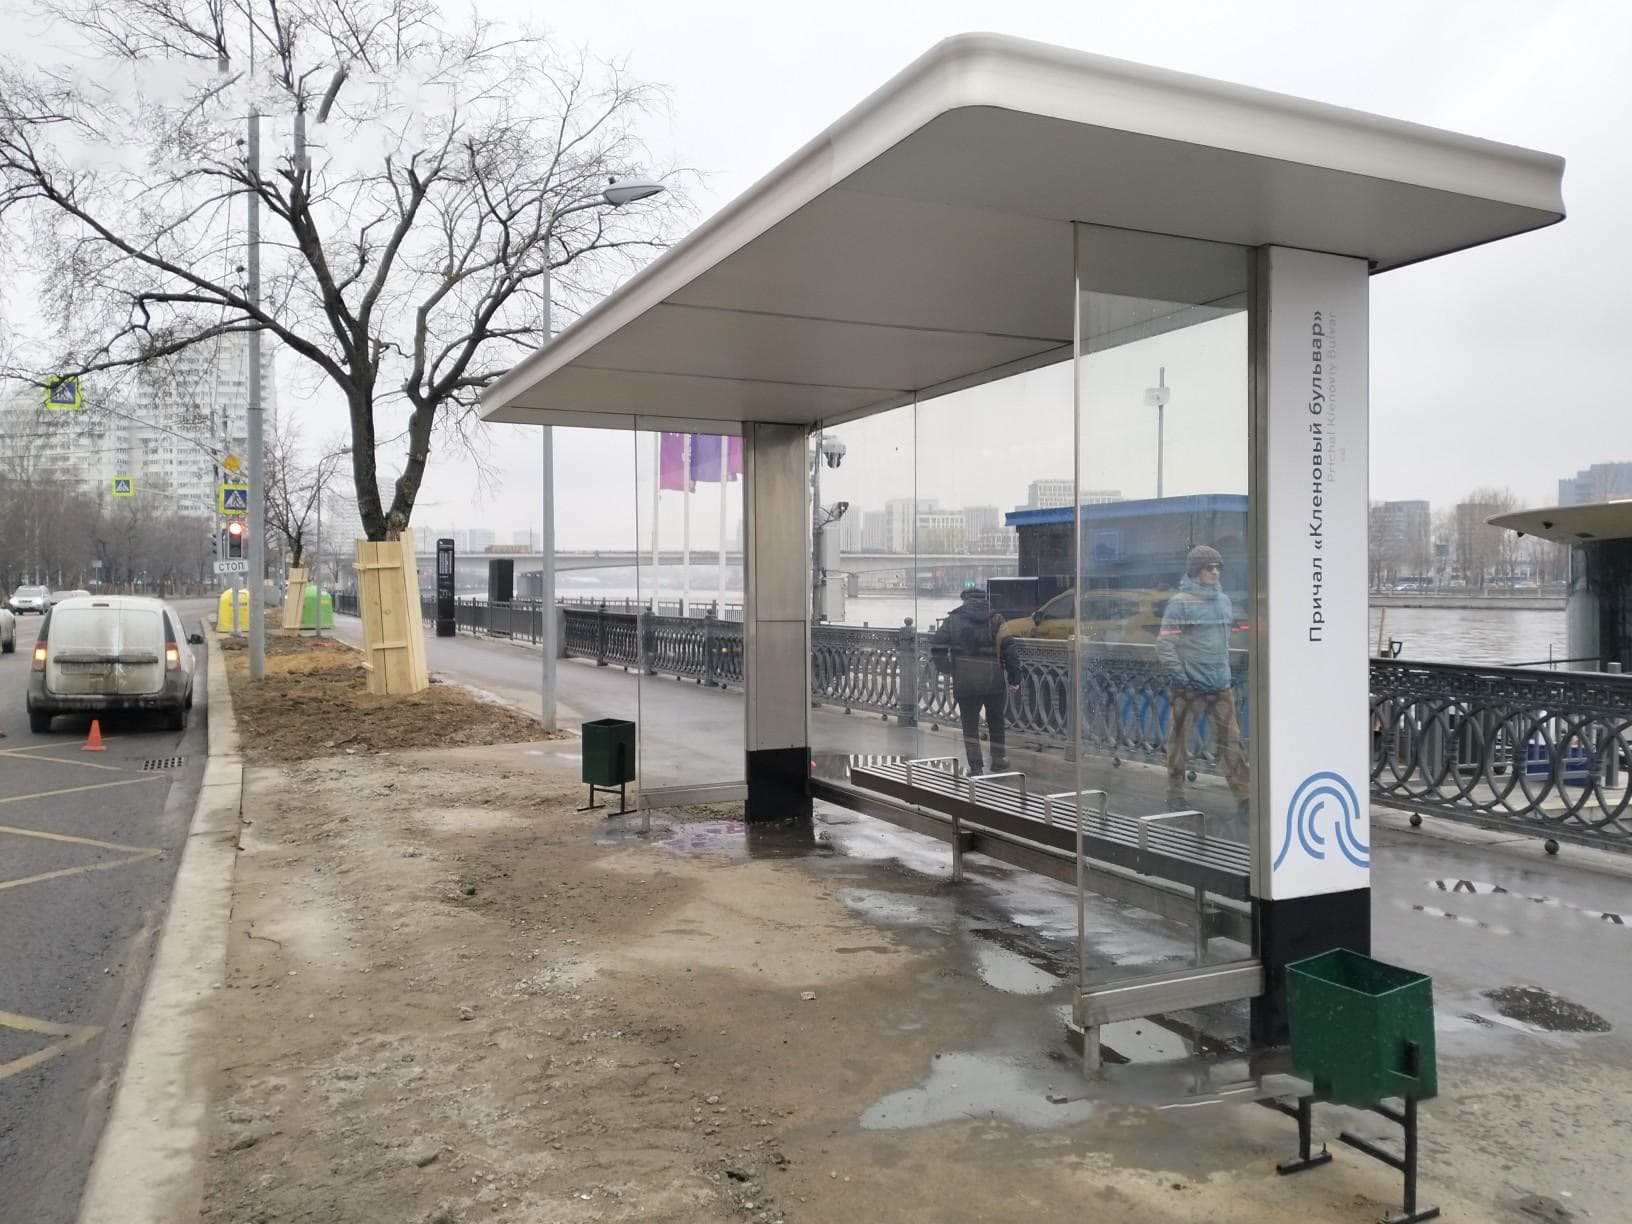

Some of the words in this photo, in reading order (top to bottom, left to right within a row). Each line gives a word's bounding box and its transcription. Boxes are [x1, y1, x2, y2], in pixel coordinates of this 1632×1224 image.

[1309, 310, 1325, 415] бульвар»
[1309, 423, 1323, 550] «Кленовый
[218, 561, 244, 571] СТОП
[1309, 557, 1325, 642] Причал
